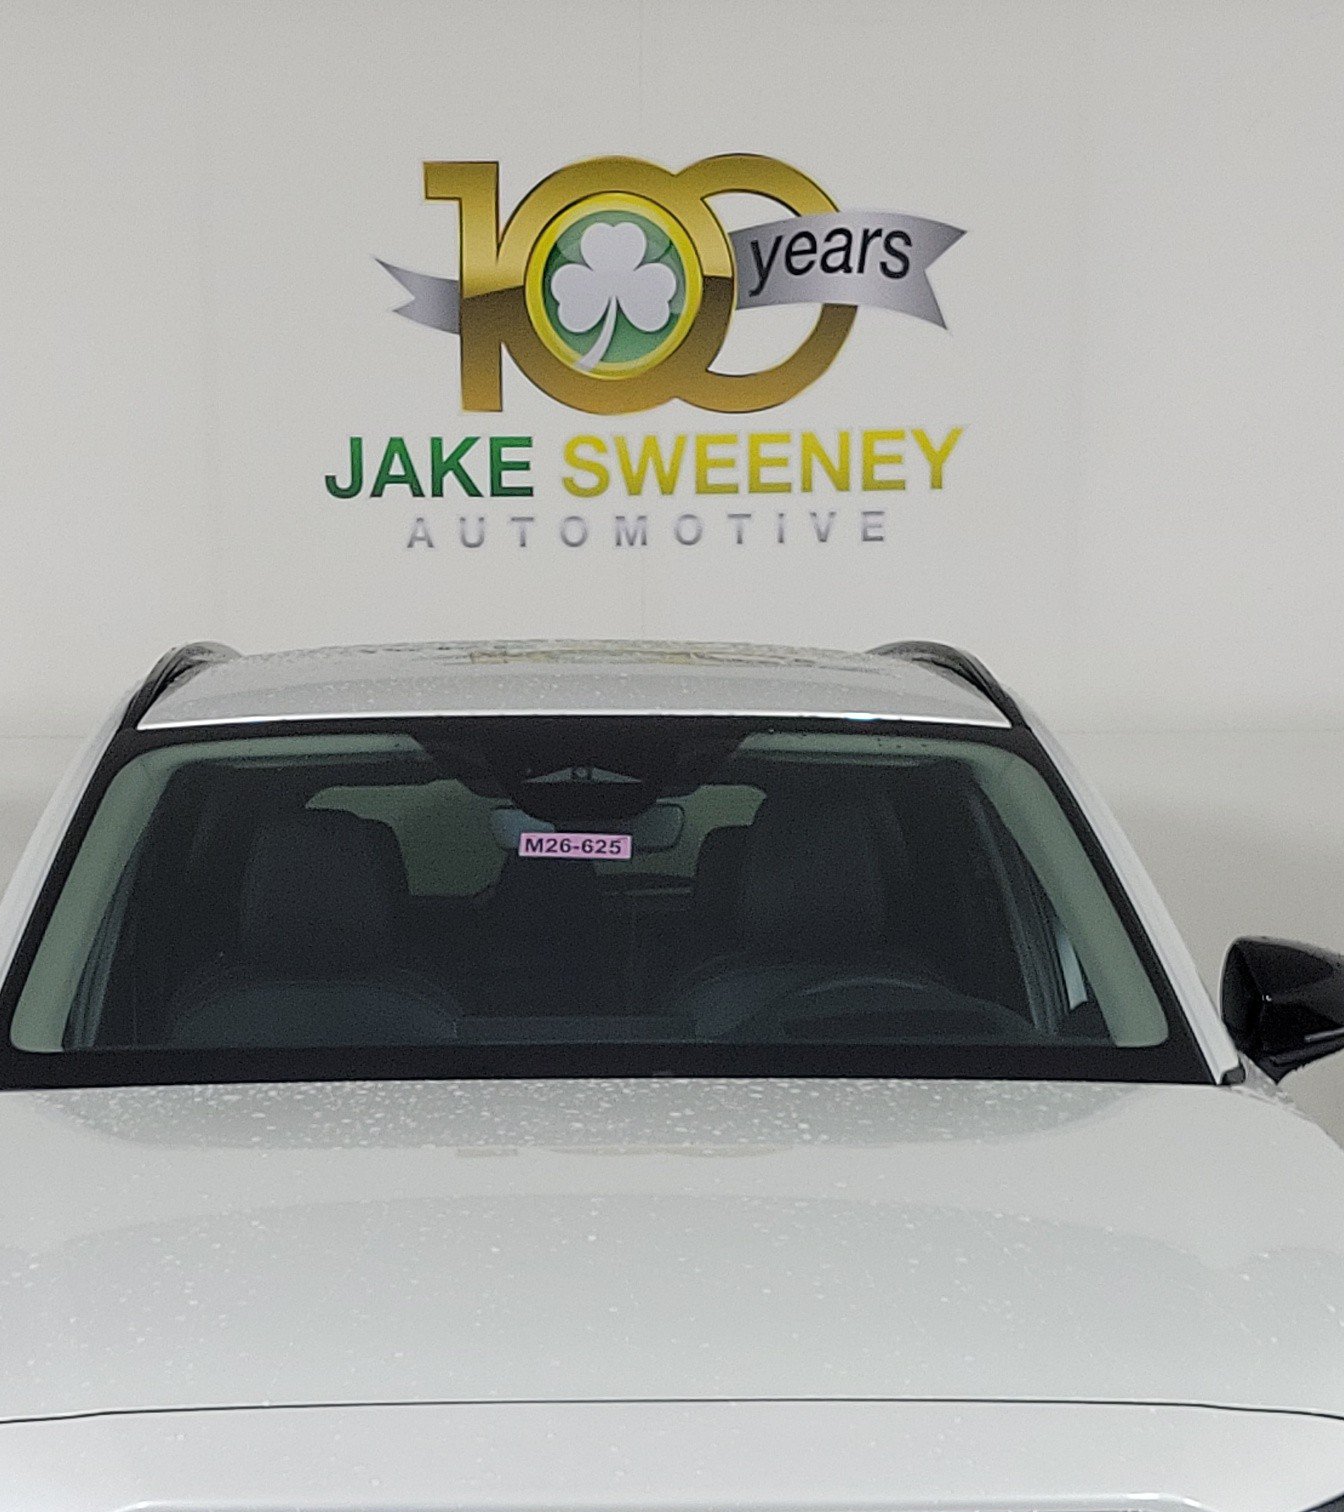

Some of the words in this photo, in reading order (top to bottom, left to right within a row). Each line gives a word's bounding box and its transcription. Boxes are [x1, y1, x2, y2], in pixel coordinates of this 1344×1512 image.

[423, 152, 858, 415] 100
[748, 227, 912, 297] years
[325, 436, 534, 499] JAKE
[561, 426, 964, 498] SWEENEY
[407, 511, 886, 549] AUTOMOTIVE
[524, 837, 622, 856] M26-625
